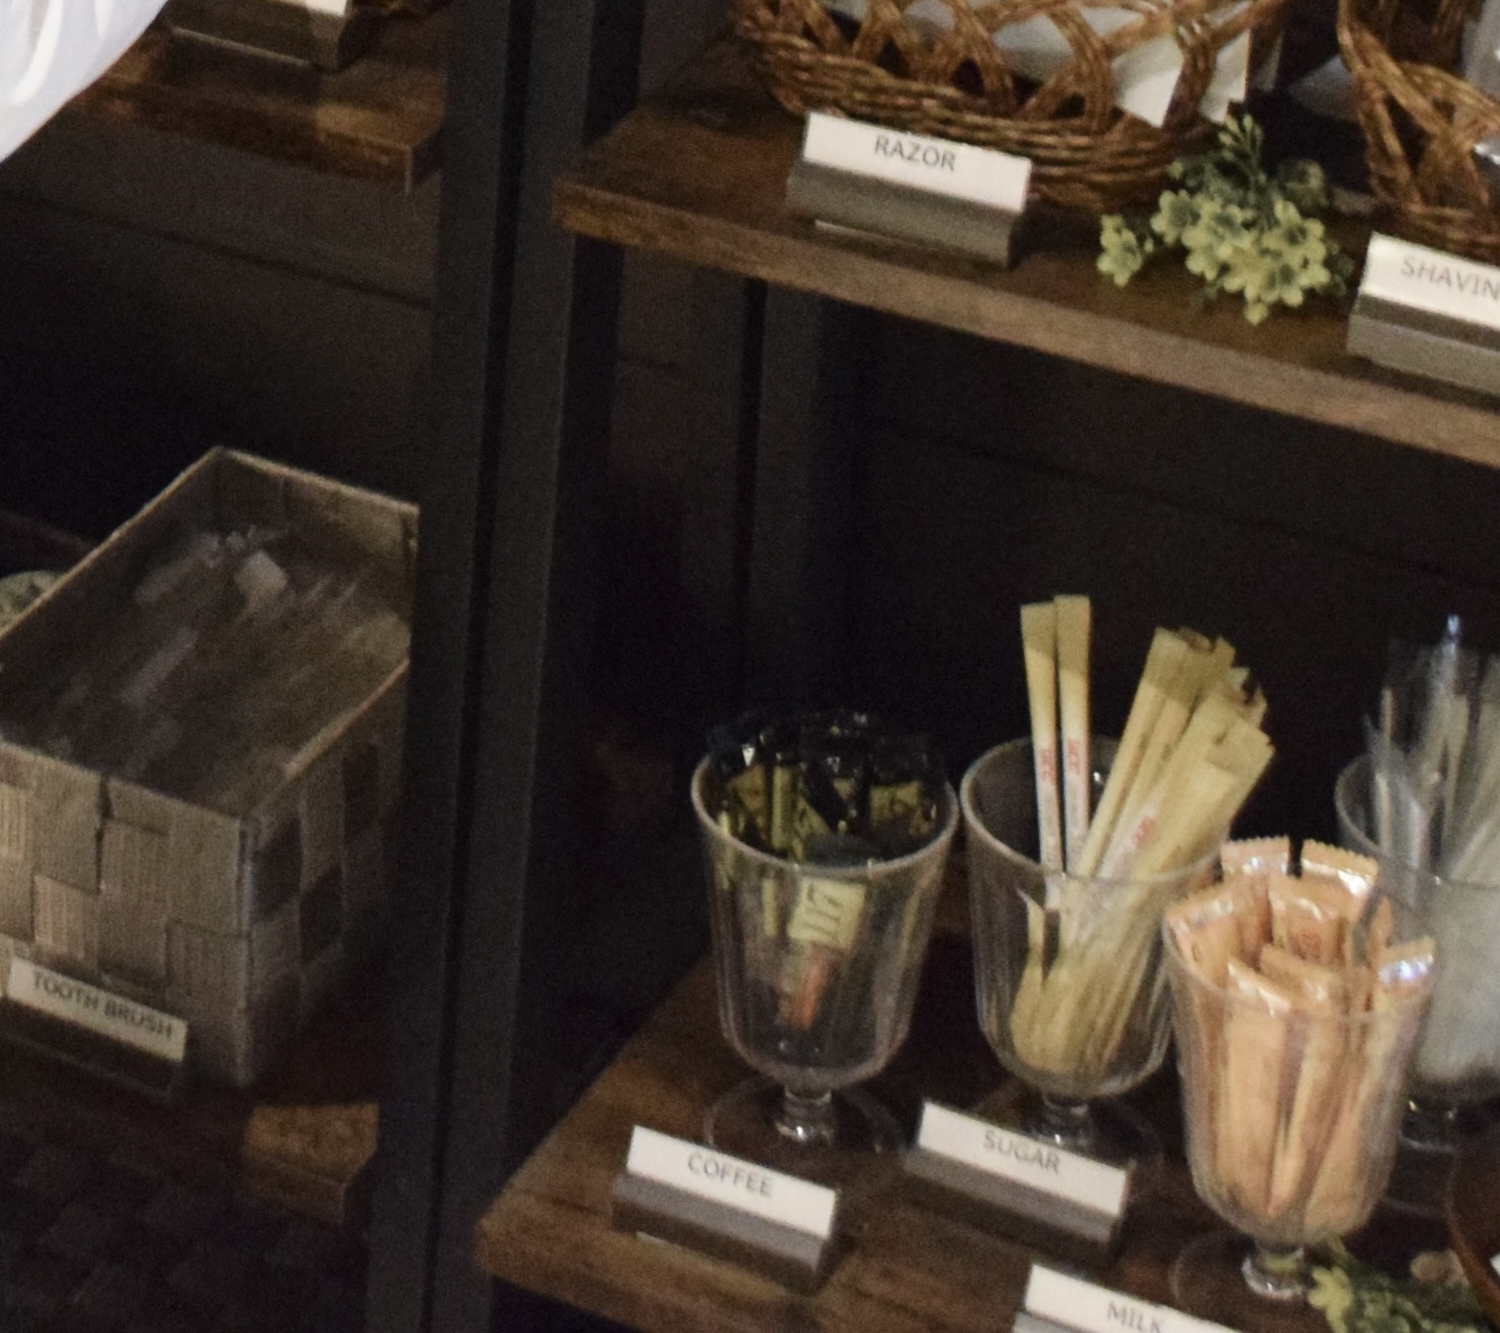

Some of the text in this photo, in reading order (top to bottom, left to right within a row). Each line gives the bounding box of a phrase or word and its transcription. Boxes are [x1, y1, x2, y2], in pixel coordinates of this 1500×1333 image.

[874, 134, 956, 171] RAZOR
[33, 970, 173, 1039] TOOTH BRUSH
[982, 1128, 1061, 1174] SUGAR
[687, 1151, 774, 1198] COFFEE
[1106, 1299, 1165, 1333] MILK
